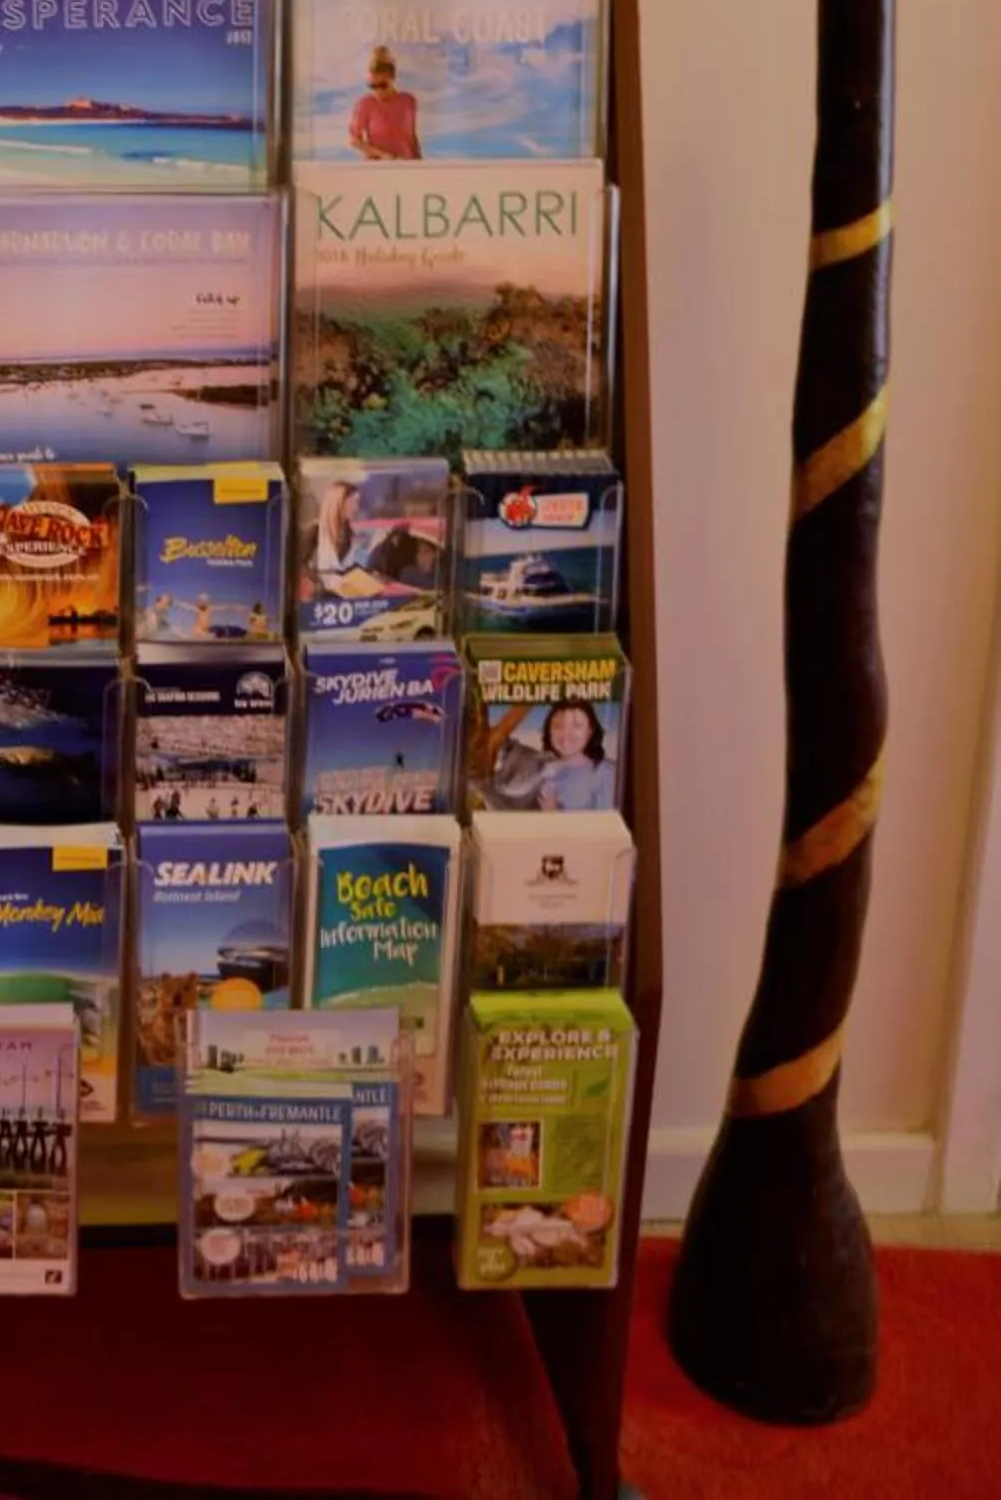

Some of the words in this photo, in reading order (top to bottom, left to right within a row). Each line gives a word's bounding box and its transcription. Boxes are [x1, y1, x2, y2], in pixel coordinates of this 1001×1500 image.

[316, 191, 577, 241] KALBARRI
[313, 602, 354, 625] $20
[315, 668, 399, 693] SKYDIVE
[503, 660, 616, 682] CAVERSHAM
[332, 684, 405, 706] JURIEN
[407, 680, 435, 697] BA
[482, 683, 559, 701] WILDLIFE
[565, 682, 612, 700] PARK
[312, 790, 434, 815] SKYDIVE
[154, 861, 278, 886] SEALINK
[336, 862, 429, 903] Beach
[351, 899, 396, 921] Safe
[320, 914, 437, 949] Information
[373, 938, 419, 966] Map
[259, 1104, 343, 1121] FREMANTLE
